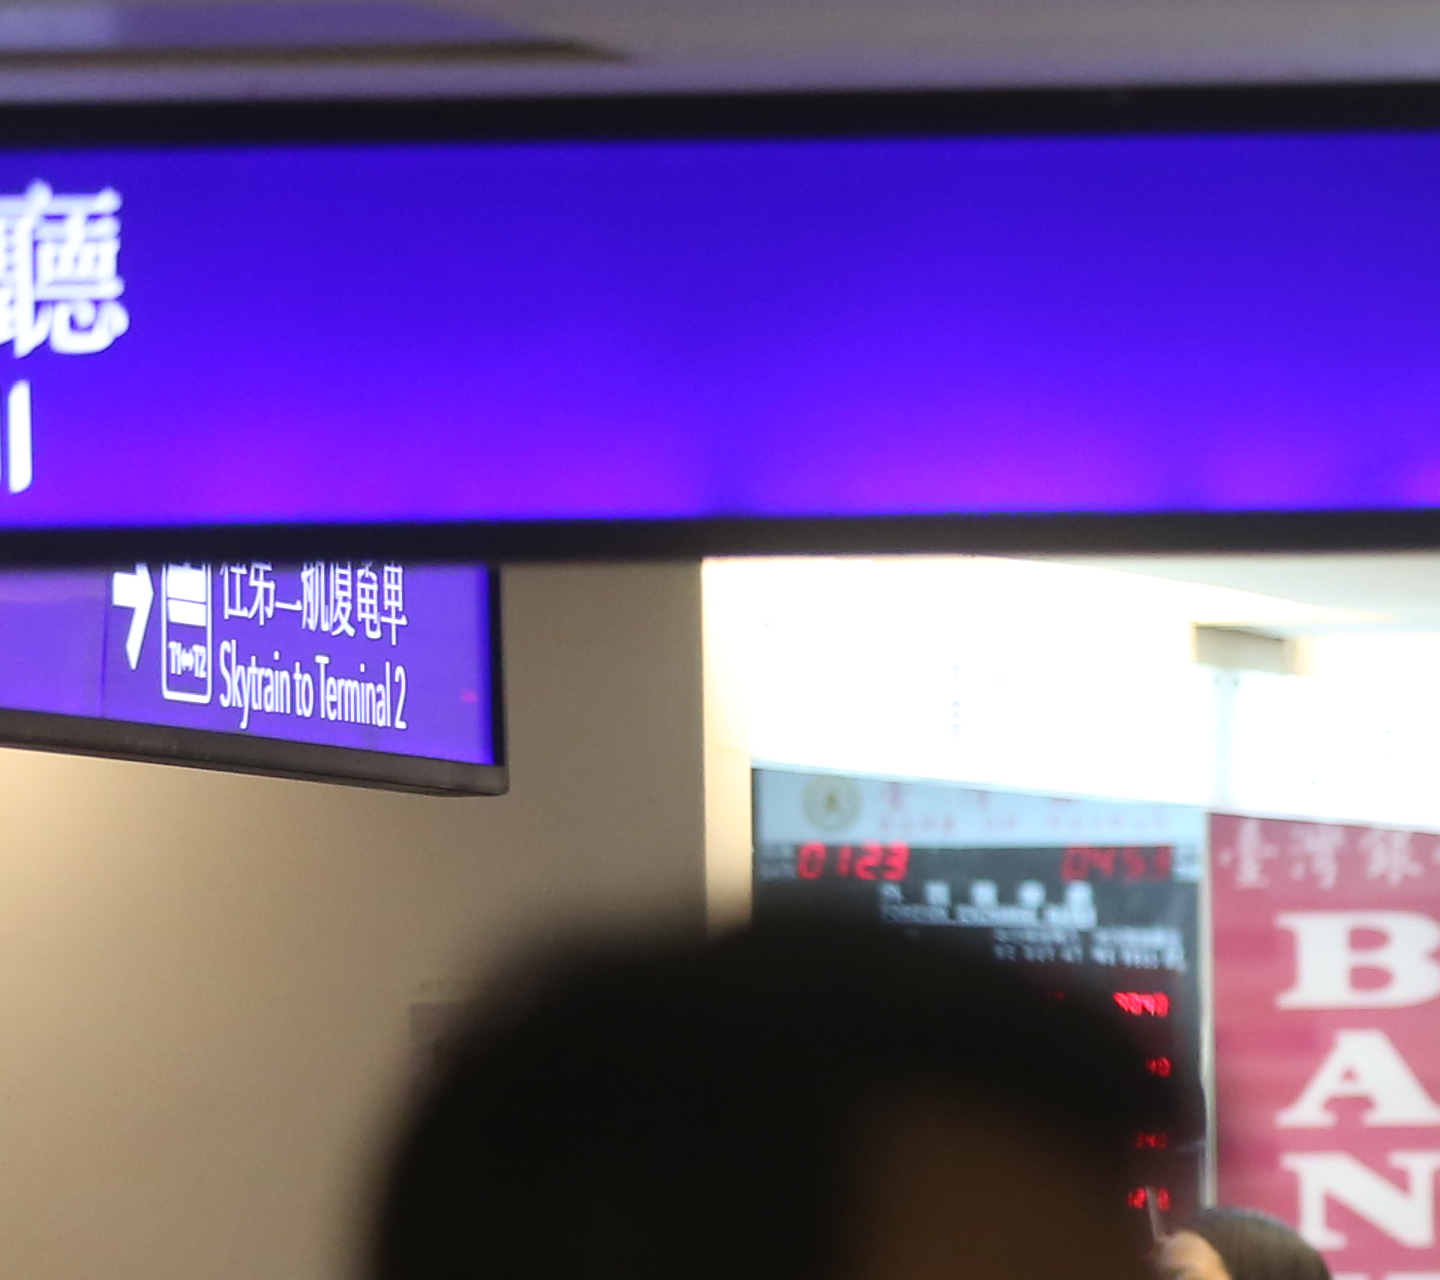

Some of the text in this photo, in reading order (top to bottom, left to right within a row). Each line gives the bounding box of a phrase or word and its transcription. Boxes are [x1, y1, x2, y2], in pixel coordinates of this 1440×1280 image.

[219, 640, 408, 730] Skytrain to Terminal 2
